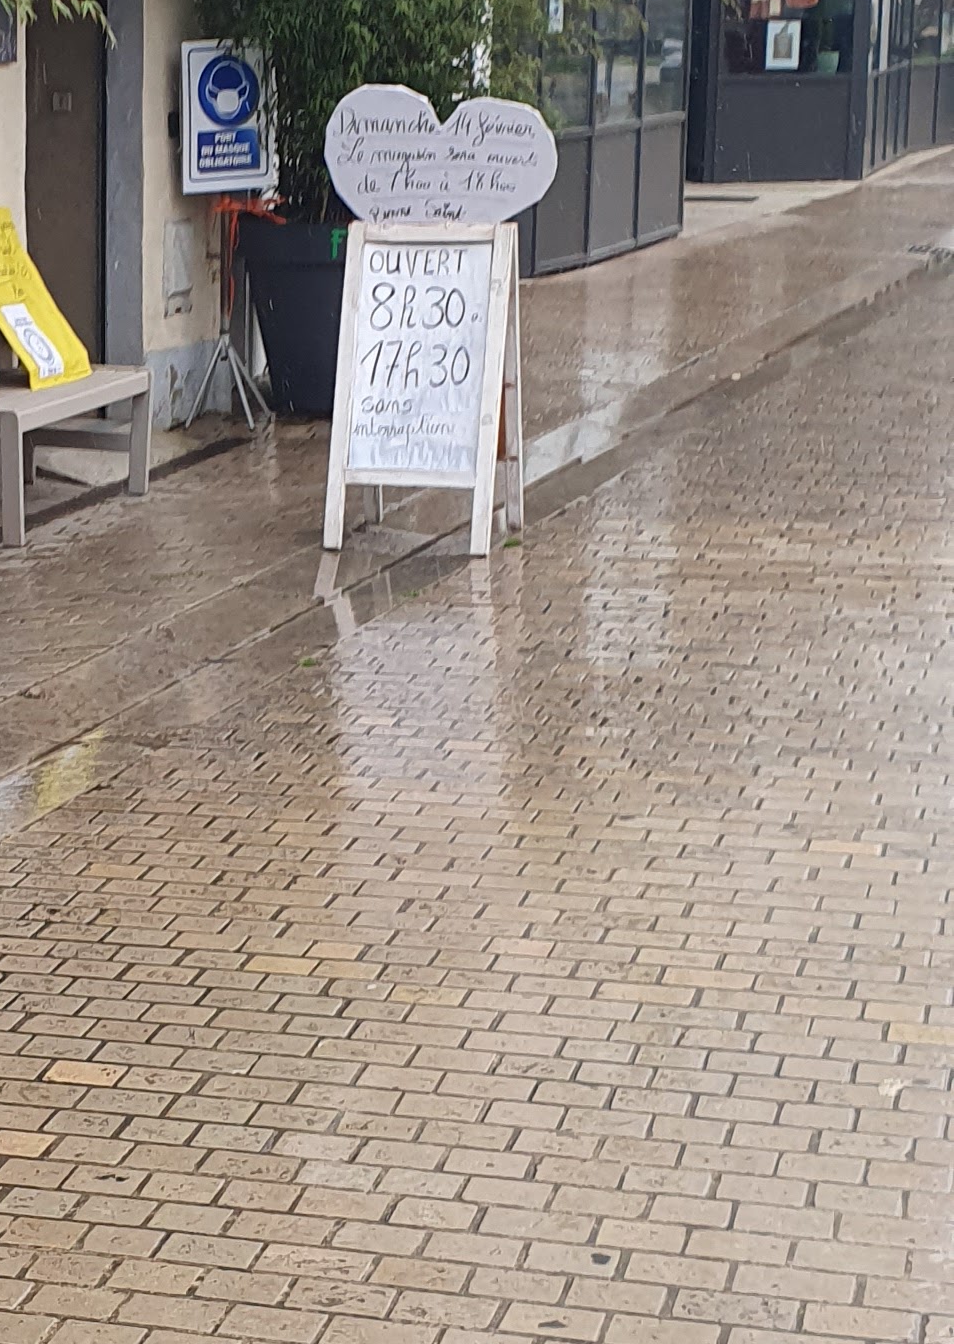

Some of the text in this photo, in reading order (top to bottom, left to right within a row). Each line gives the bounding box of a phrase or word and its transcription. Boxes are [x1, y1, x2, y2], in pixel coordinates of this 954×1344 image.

[214, 132, 236, 144] PORT
[369, 249, 467, 278] OUVERT
[361, 396, 413, 416] sans
